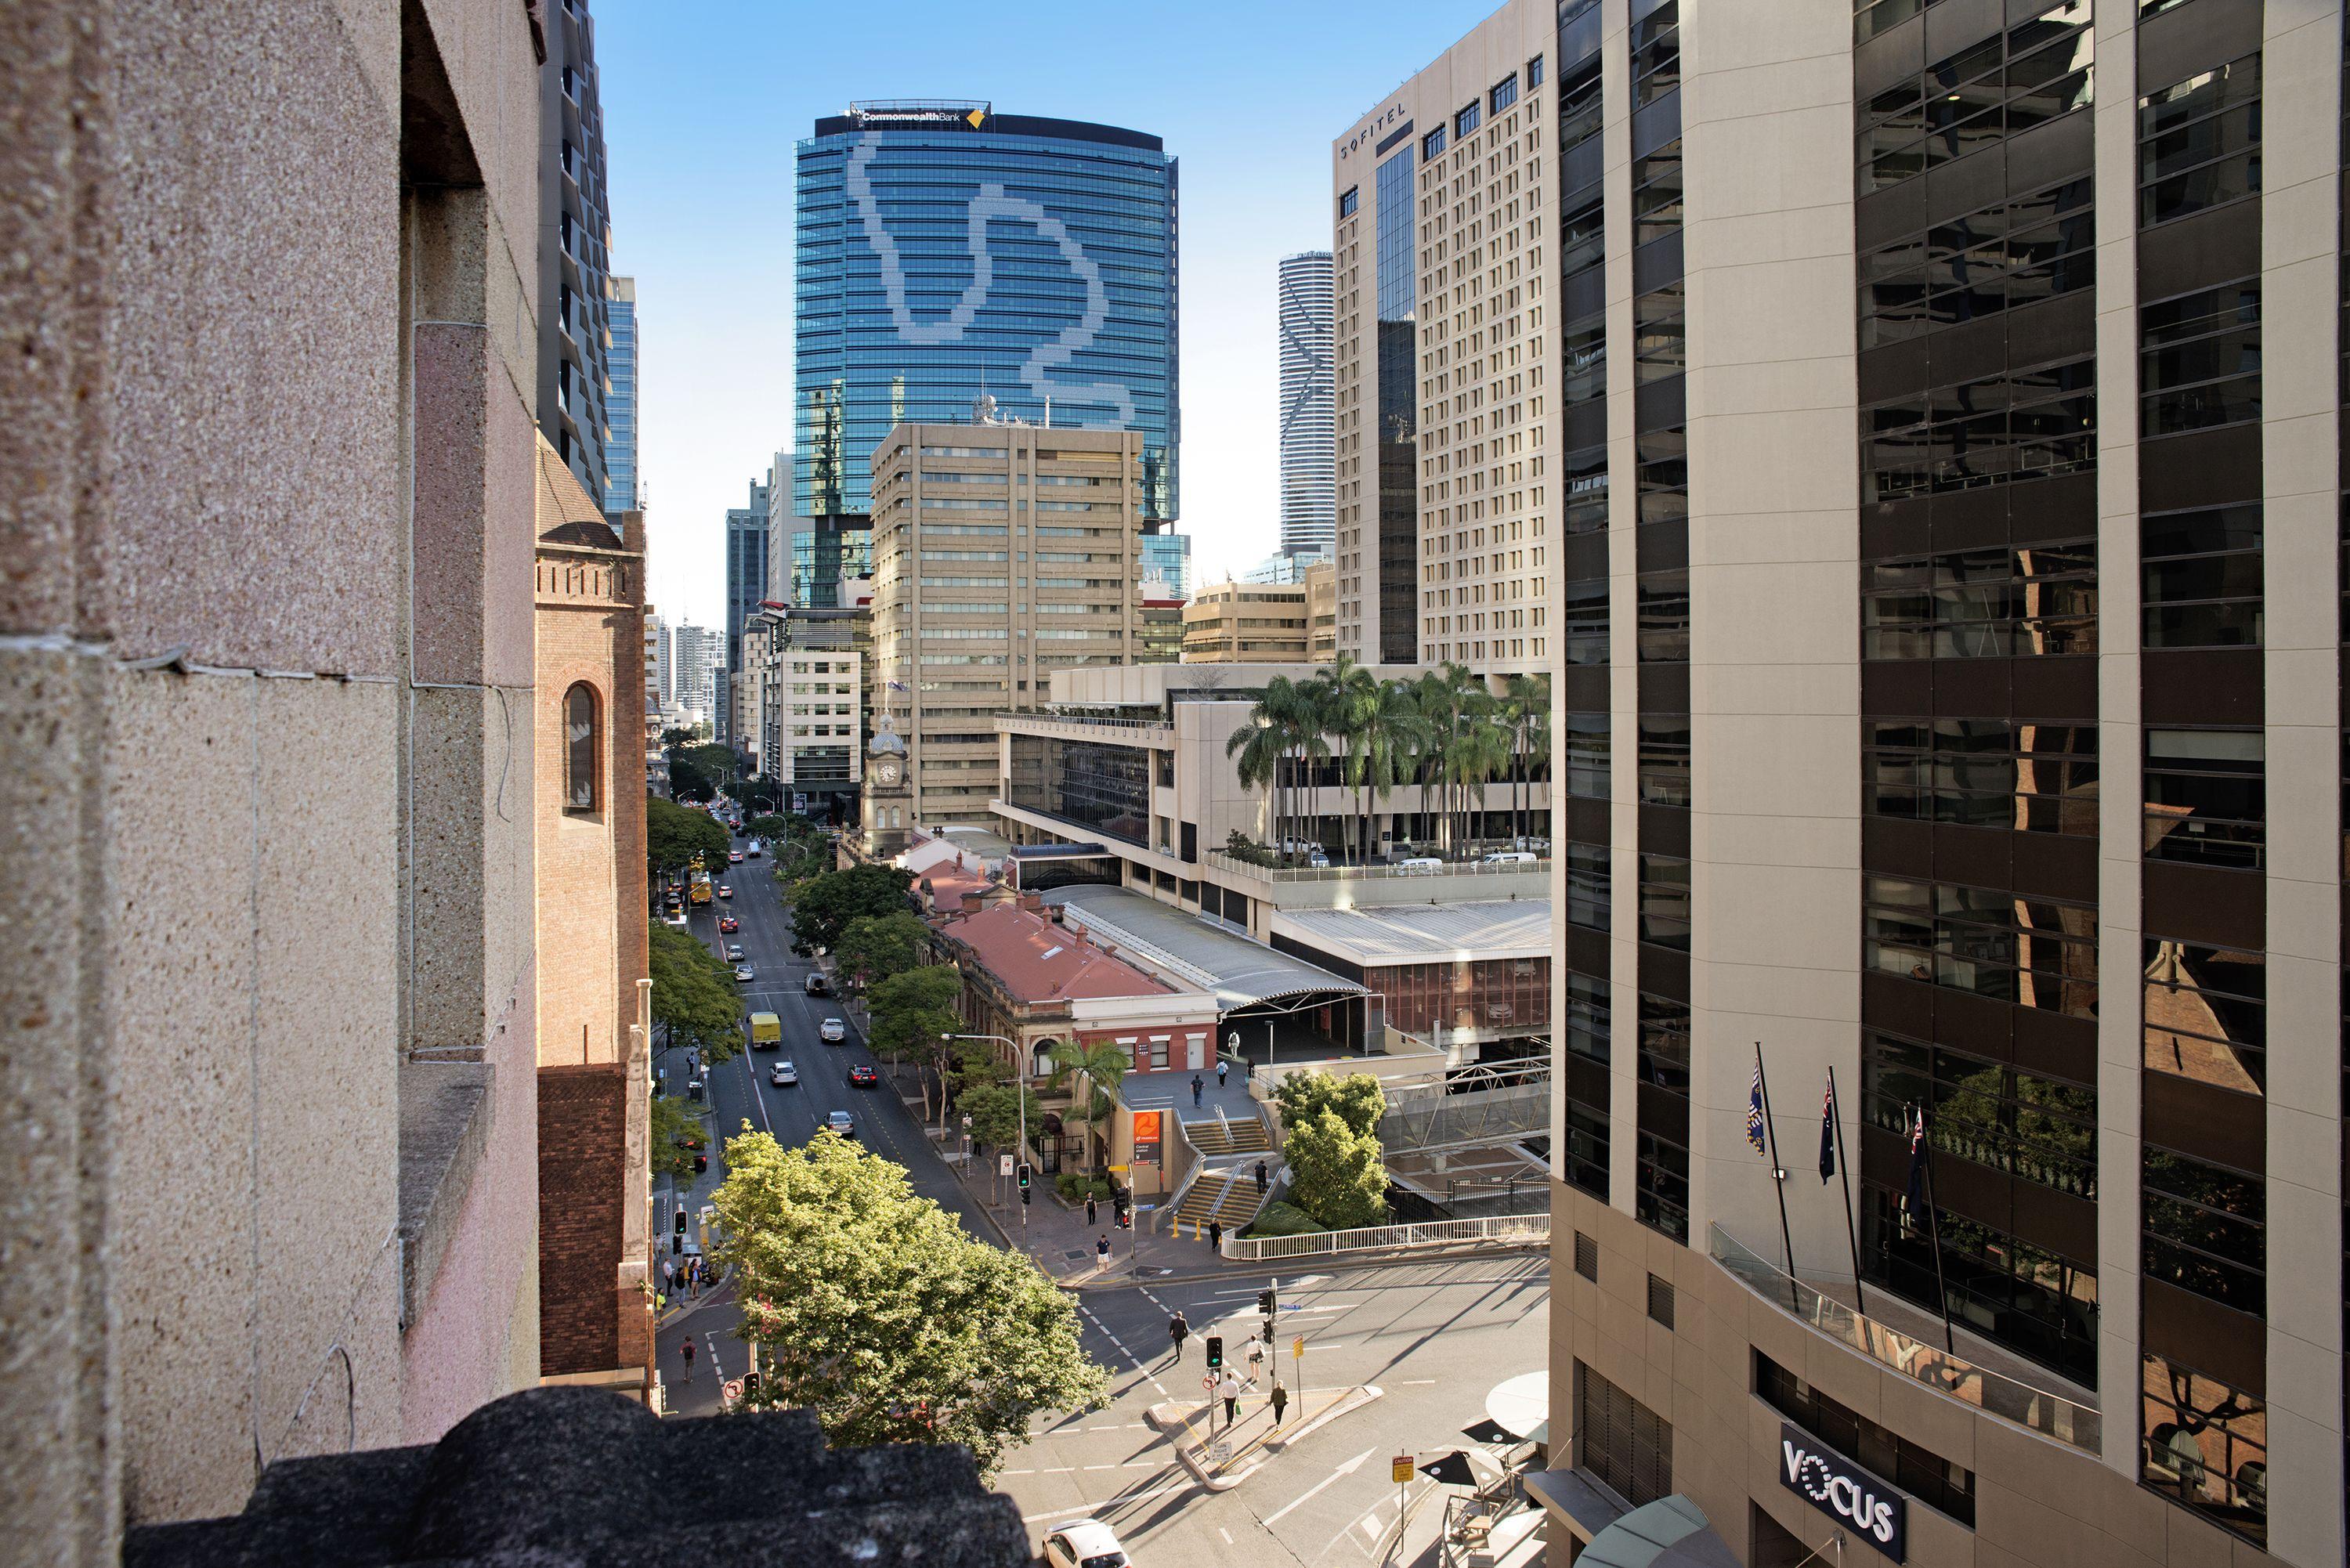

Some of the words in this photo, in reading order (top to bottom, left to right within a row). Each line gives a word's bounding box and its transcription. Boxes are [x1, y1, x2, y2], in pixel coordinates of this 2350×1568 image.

[863, 112, 960, 122] CommonwealthBank
[1341, 103, 1405, 159] SOFITEL
[1784, 1440, 1893, 1542] VOCUS
